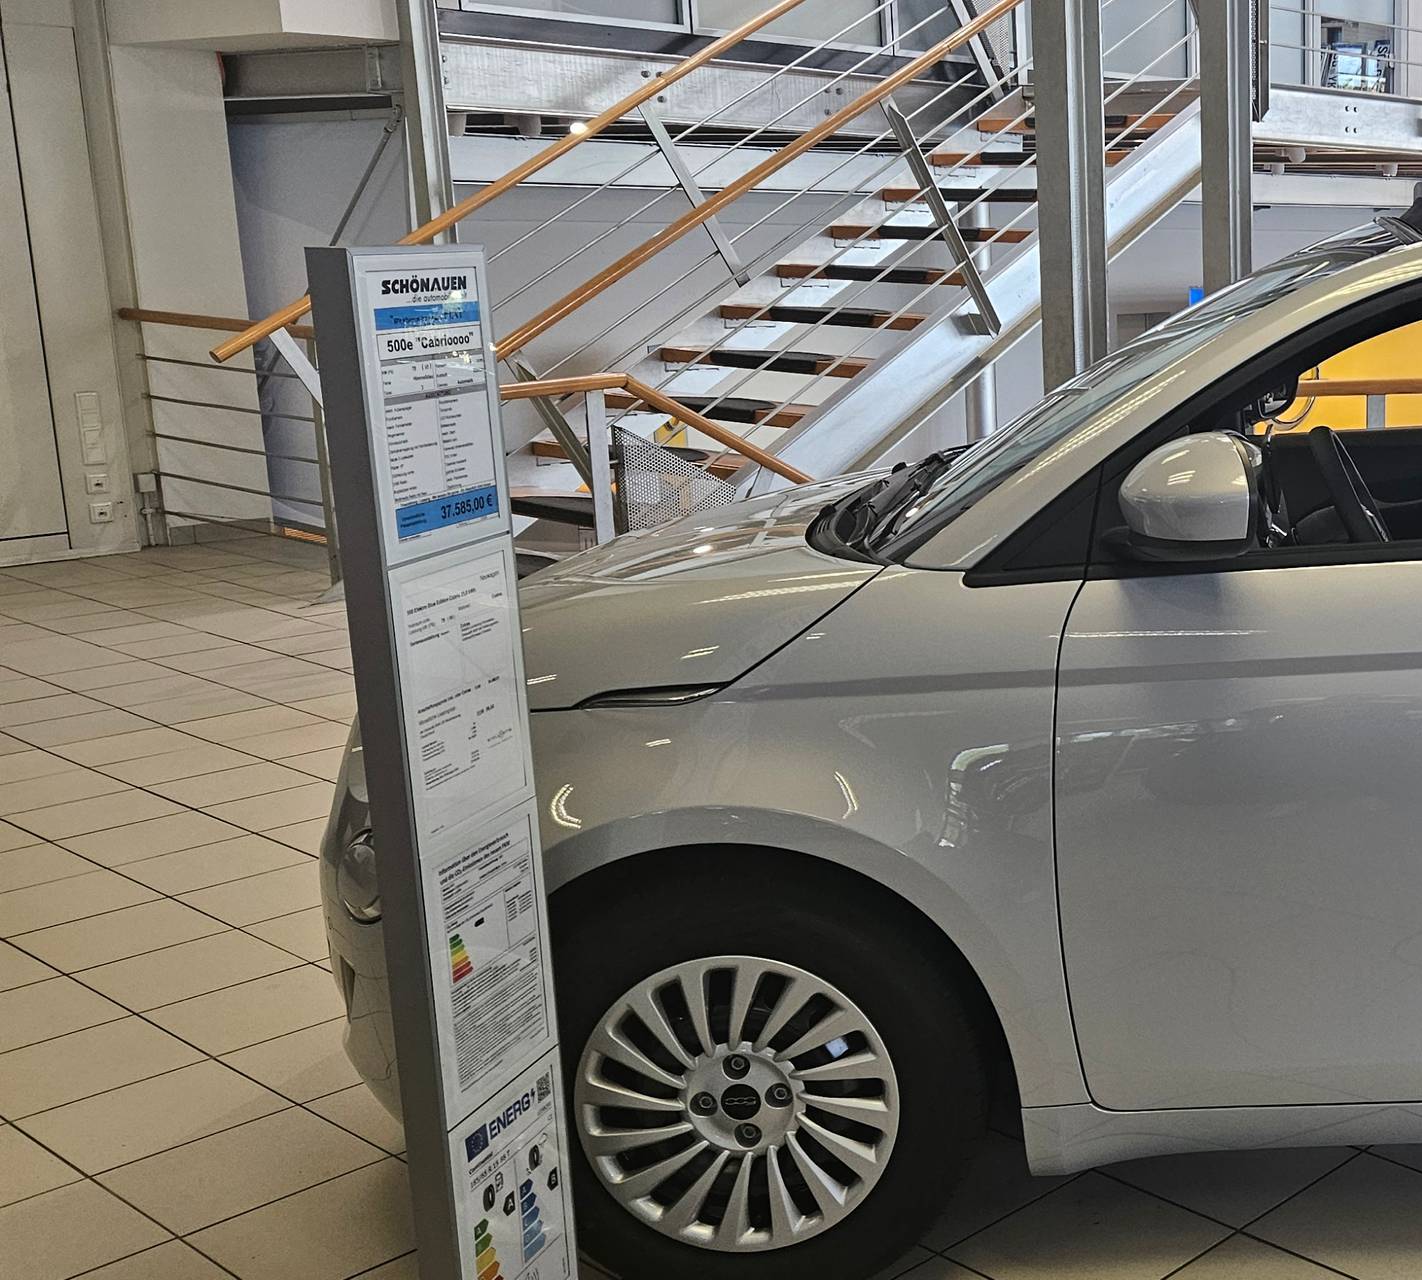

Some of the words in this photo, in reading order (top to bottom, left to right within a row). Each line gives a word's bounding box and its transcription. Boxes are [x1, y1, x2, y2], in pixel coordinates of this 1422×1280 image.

[381, 275, 467, 295] SCHÖNAUEN
[387, 339, 414, 353] 500e
[415, 332, 474, 349] "Cabrioooo"
[441, 496, 485, 519] 37.585,00
[487, 494, 493, 507] €
